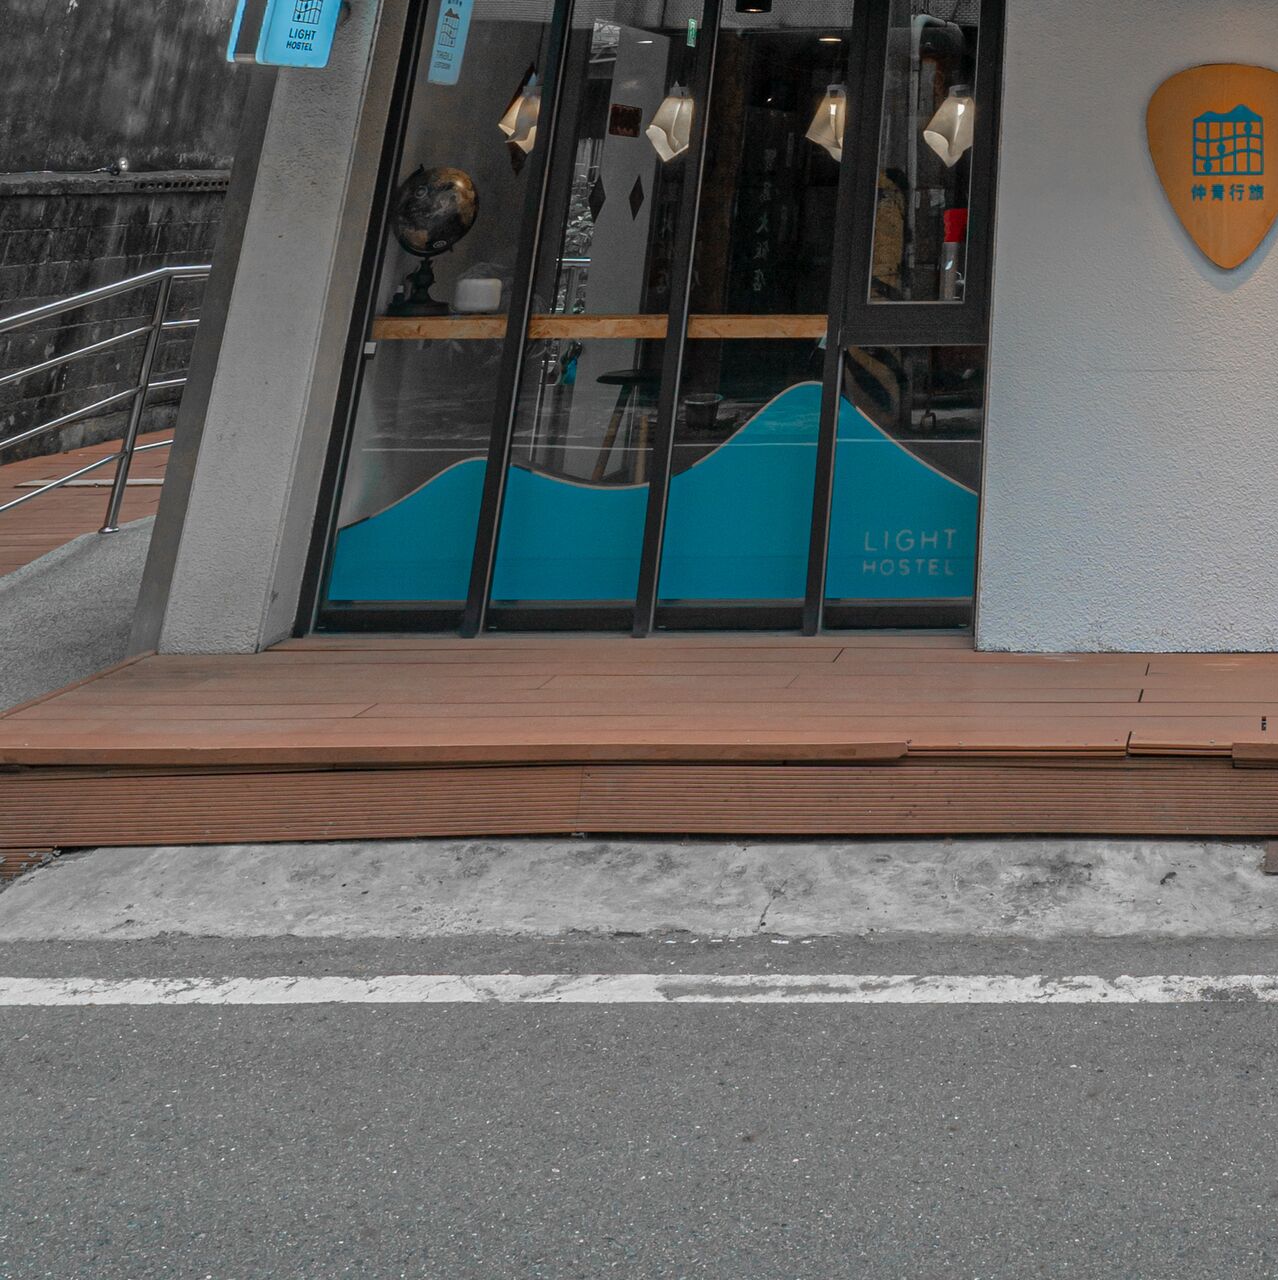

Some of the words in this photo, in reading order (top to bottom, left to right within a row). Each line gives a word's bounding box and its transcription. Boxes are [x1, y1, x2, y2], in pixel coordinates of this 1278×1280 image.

[288, 28, 317, 40] LIGHT
[286, 40, 313, 51] HOSTEL
[864, 528, 957, 552] LIGHT
[862, 558, 955, 576] HOSTEL
